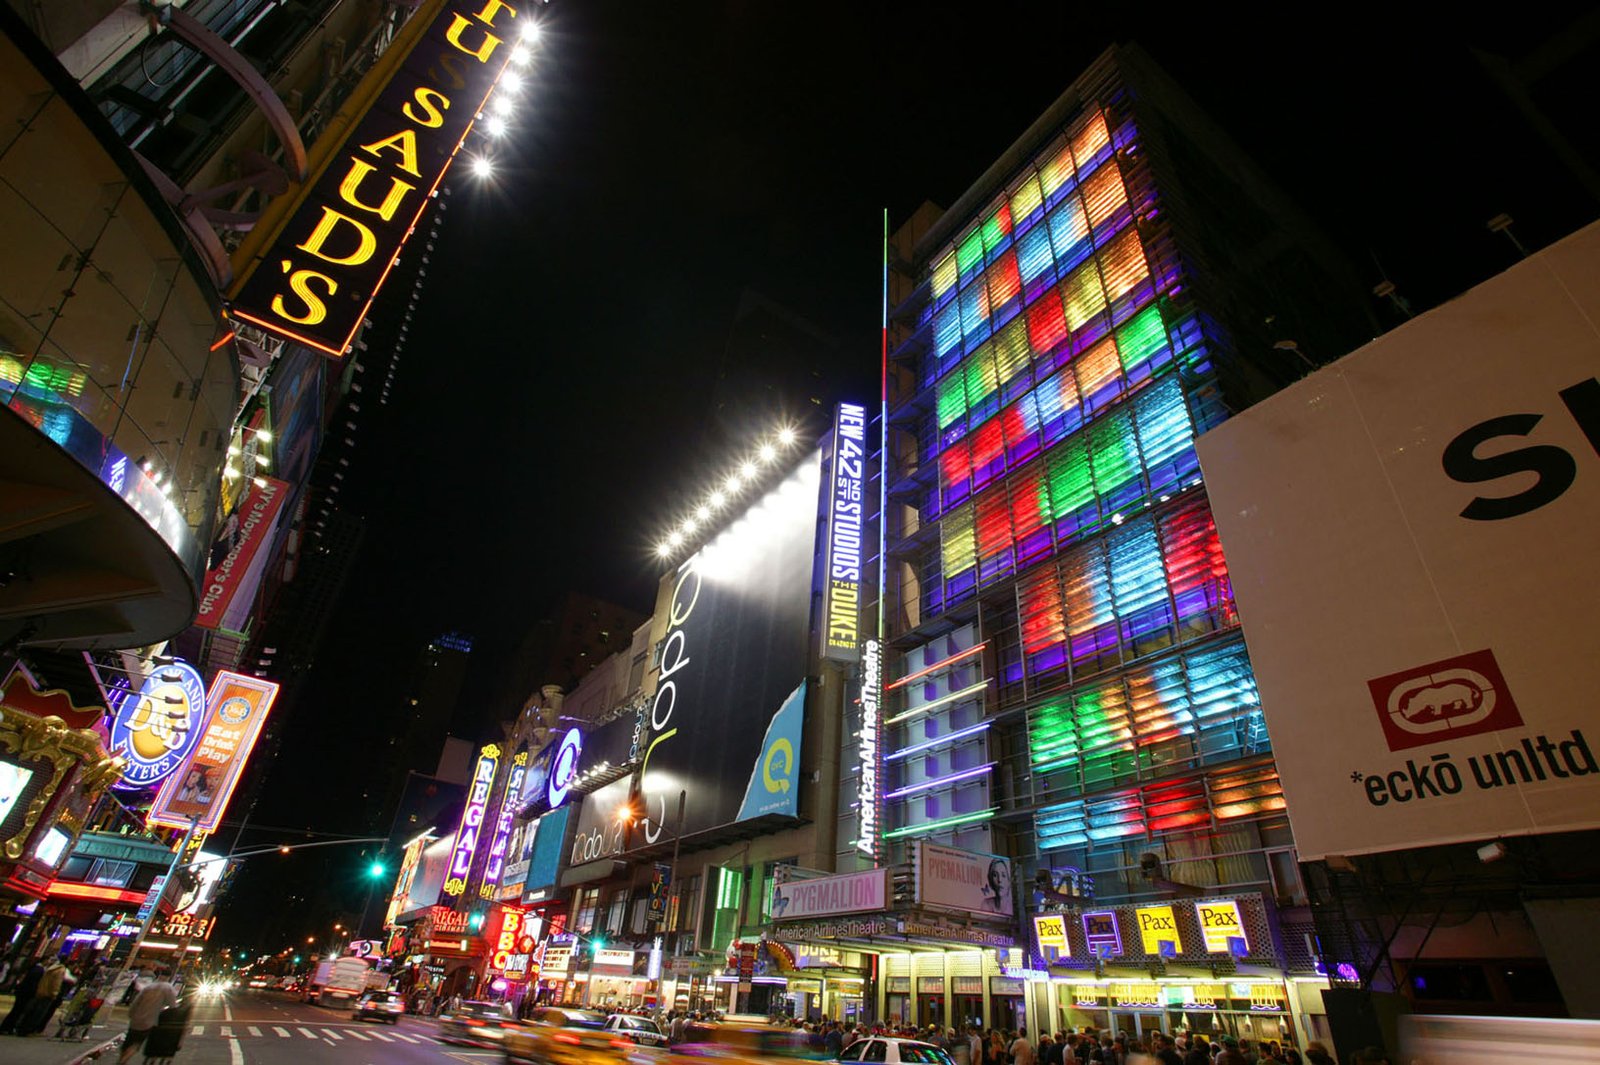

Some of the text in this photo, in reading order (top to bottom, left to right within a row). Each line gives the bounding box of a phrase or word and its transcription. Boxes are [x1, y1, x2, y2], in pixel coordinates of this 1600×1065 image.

[839, 403, 864, 440] NEW
[1442, 377, 1600, 521] S
[832, 500, 862, 581] STUDIOS
[199, 584, 224, 615] Club
[830, 580, 858, 640] THE DUKE
[183, 678, 201, 712] AND
[202, 736, 235, 750] Drink
[209, 725, 241, 740] Eat
[197, 746, 231, 763] Play
[1467, 729, 1600, 788] unltd
[452, 760, 494, 875] REGAL
[929, 858, 983, 886] PYGMALION
[791, 876, 876, 912] PYGMALION
[432, 911, 470, 926] REGAL
[1038, 920, 1064, 937] Pax
[1140, 914, 1175, 930] Pax
[1200, 908, 1239, 927] Pax
